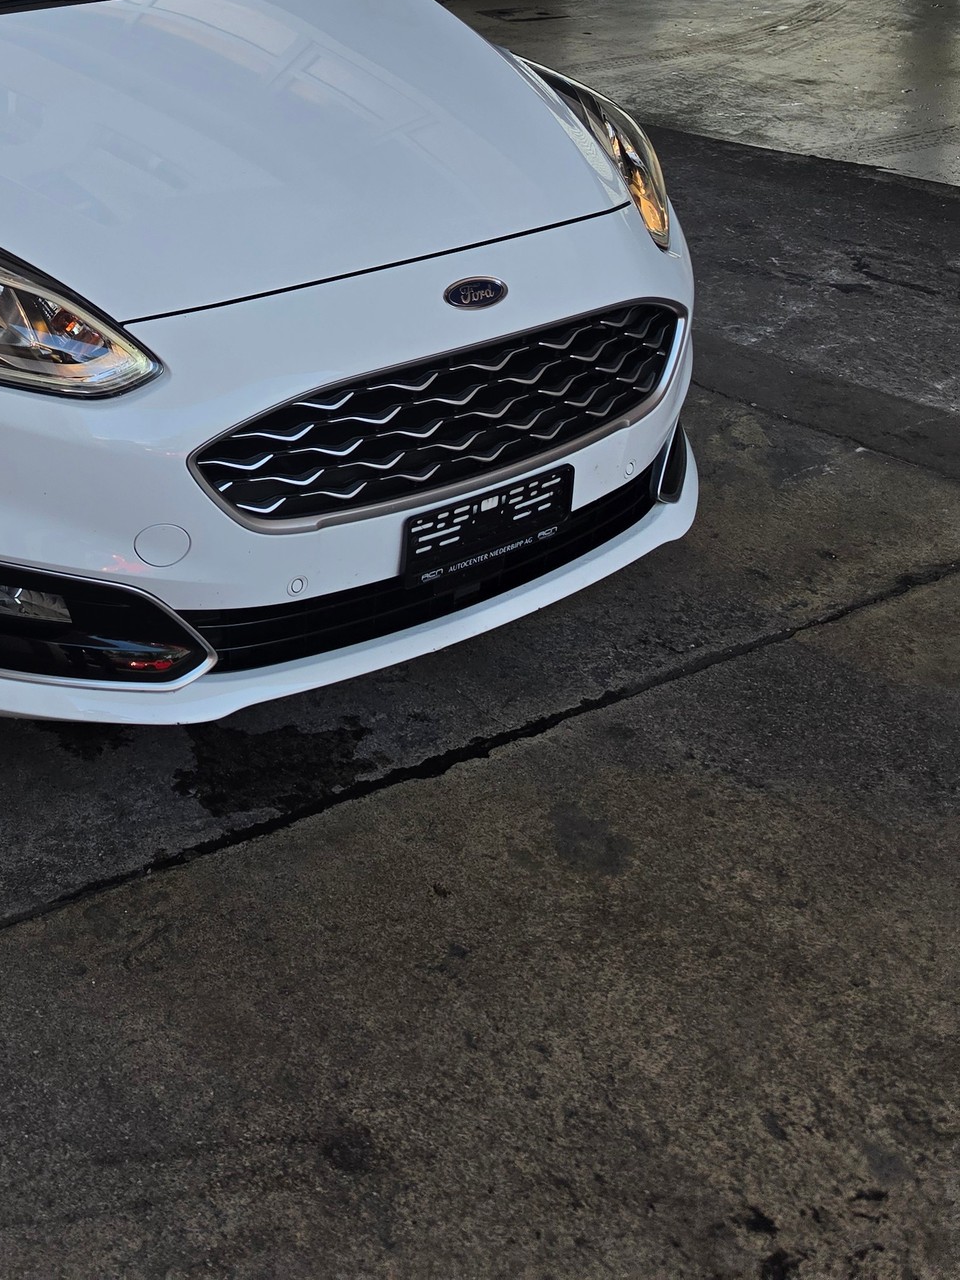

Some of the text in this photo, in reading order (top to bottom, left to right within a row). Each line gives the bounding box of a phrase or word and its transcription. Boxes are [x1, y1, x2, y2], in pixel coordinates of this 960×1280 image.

[460, 283, 495, 304] Ford
[448, 553, 489, 573] AUTOCENTER
[489, 540, 524, 558] NIEDERBIPP
[524, 536, 534, 545] AG
